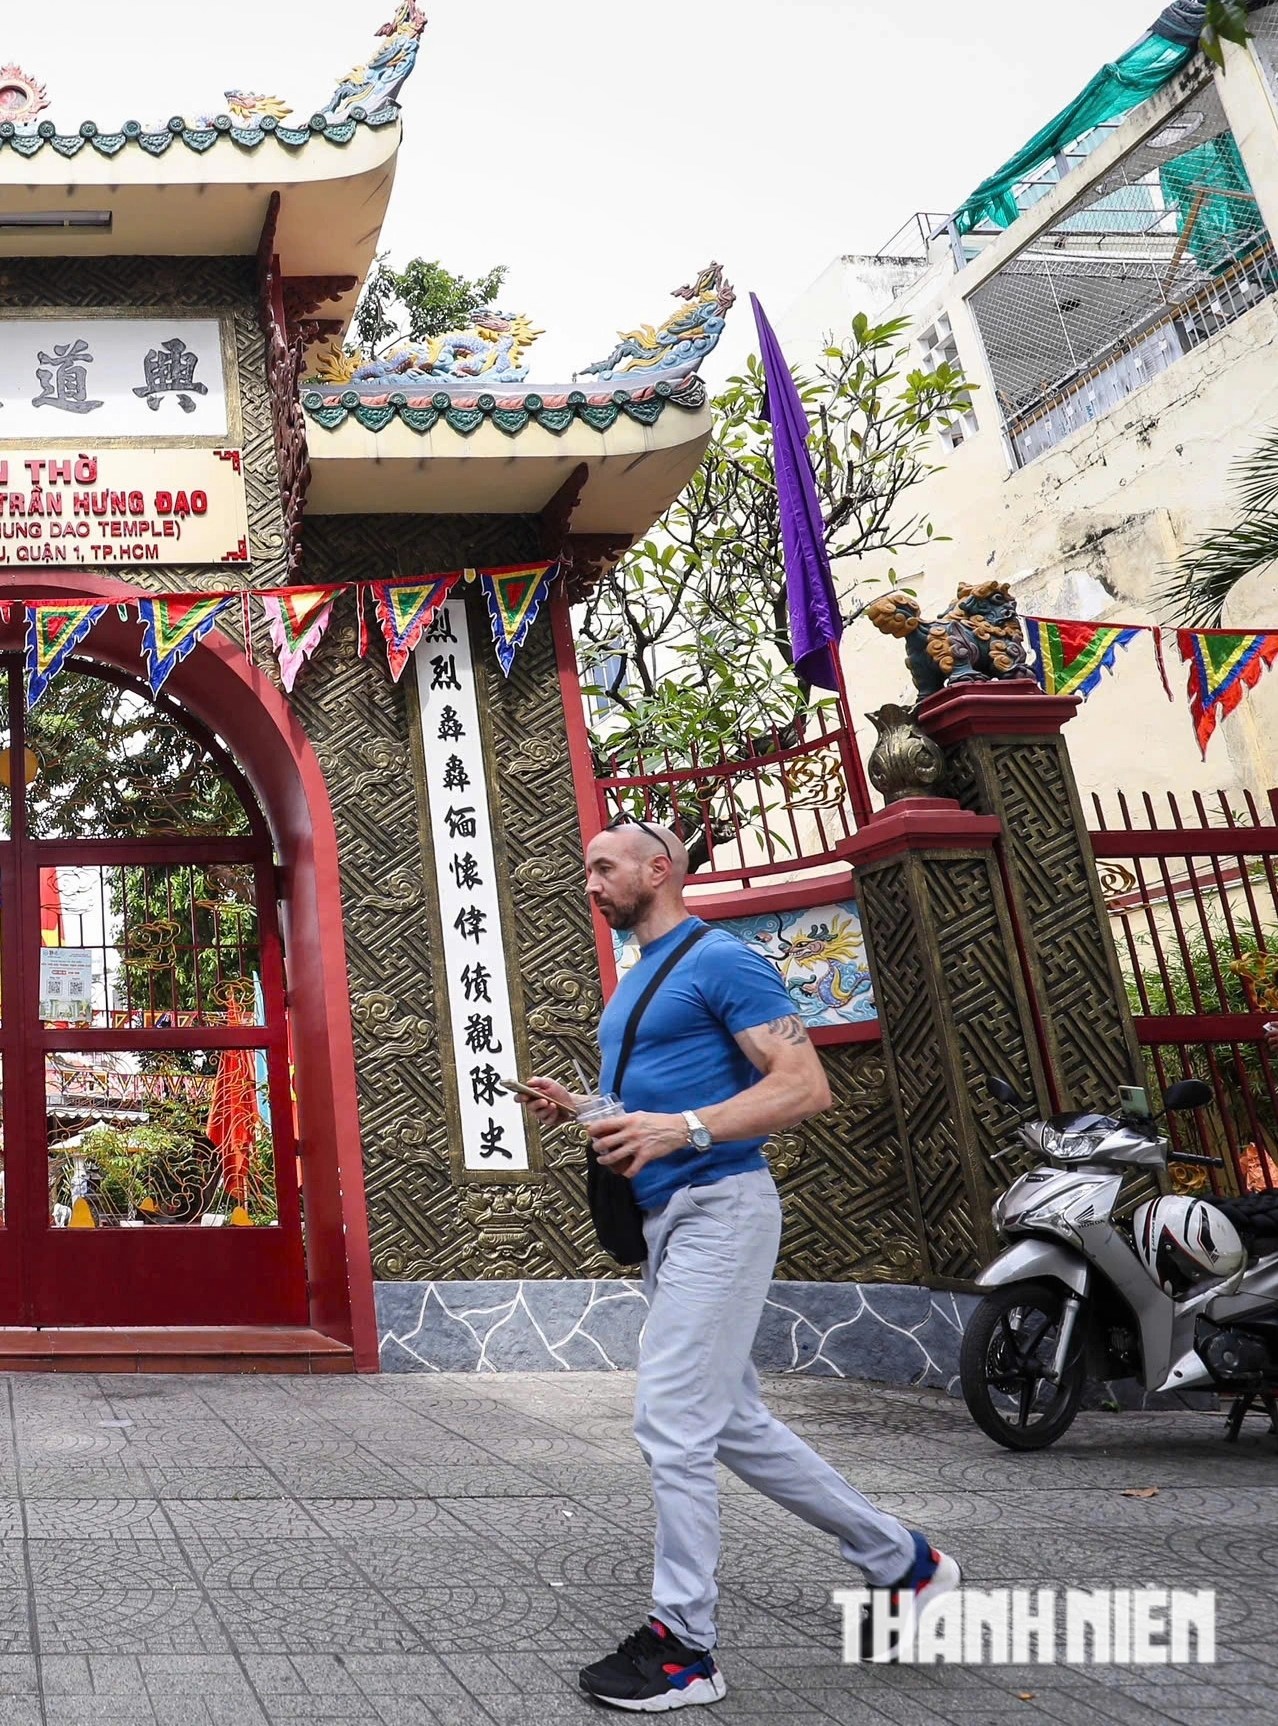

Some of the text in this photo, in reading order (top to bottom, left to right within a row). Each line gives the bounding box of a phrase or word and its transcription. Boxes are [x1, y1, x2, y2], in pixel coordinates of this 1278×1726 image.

[24, 453, 98, 485] THỜ
[74, 489, 144, 516] HƯNG
[154, 490, 208, 520] ĐẠO
[50, 521, 90, 538] DAO
[98, 520, 182, 541] TEMPLE)
[16, 542, 67, 563] QUẬN
[73, 545, 84, 562] 1,
[91, 544, 159, 560] TP.HCM
[1078, 1219, 1106, 1229] HONDA
